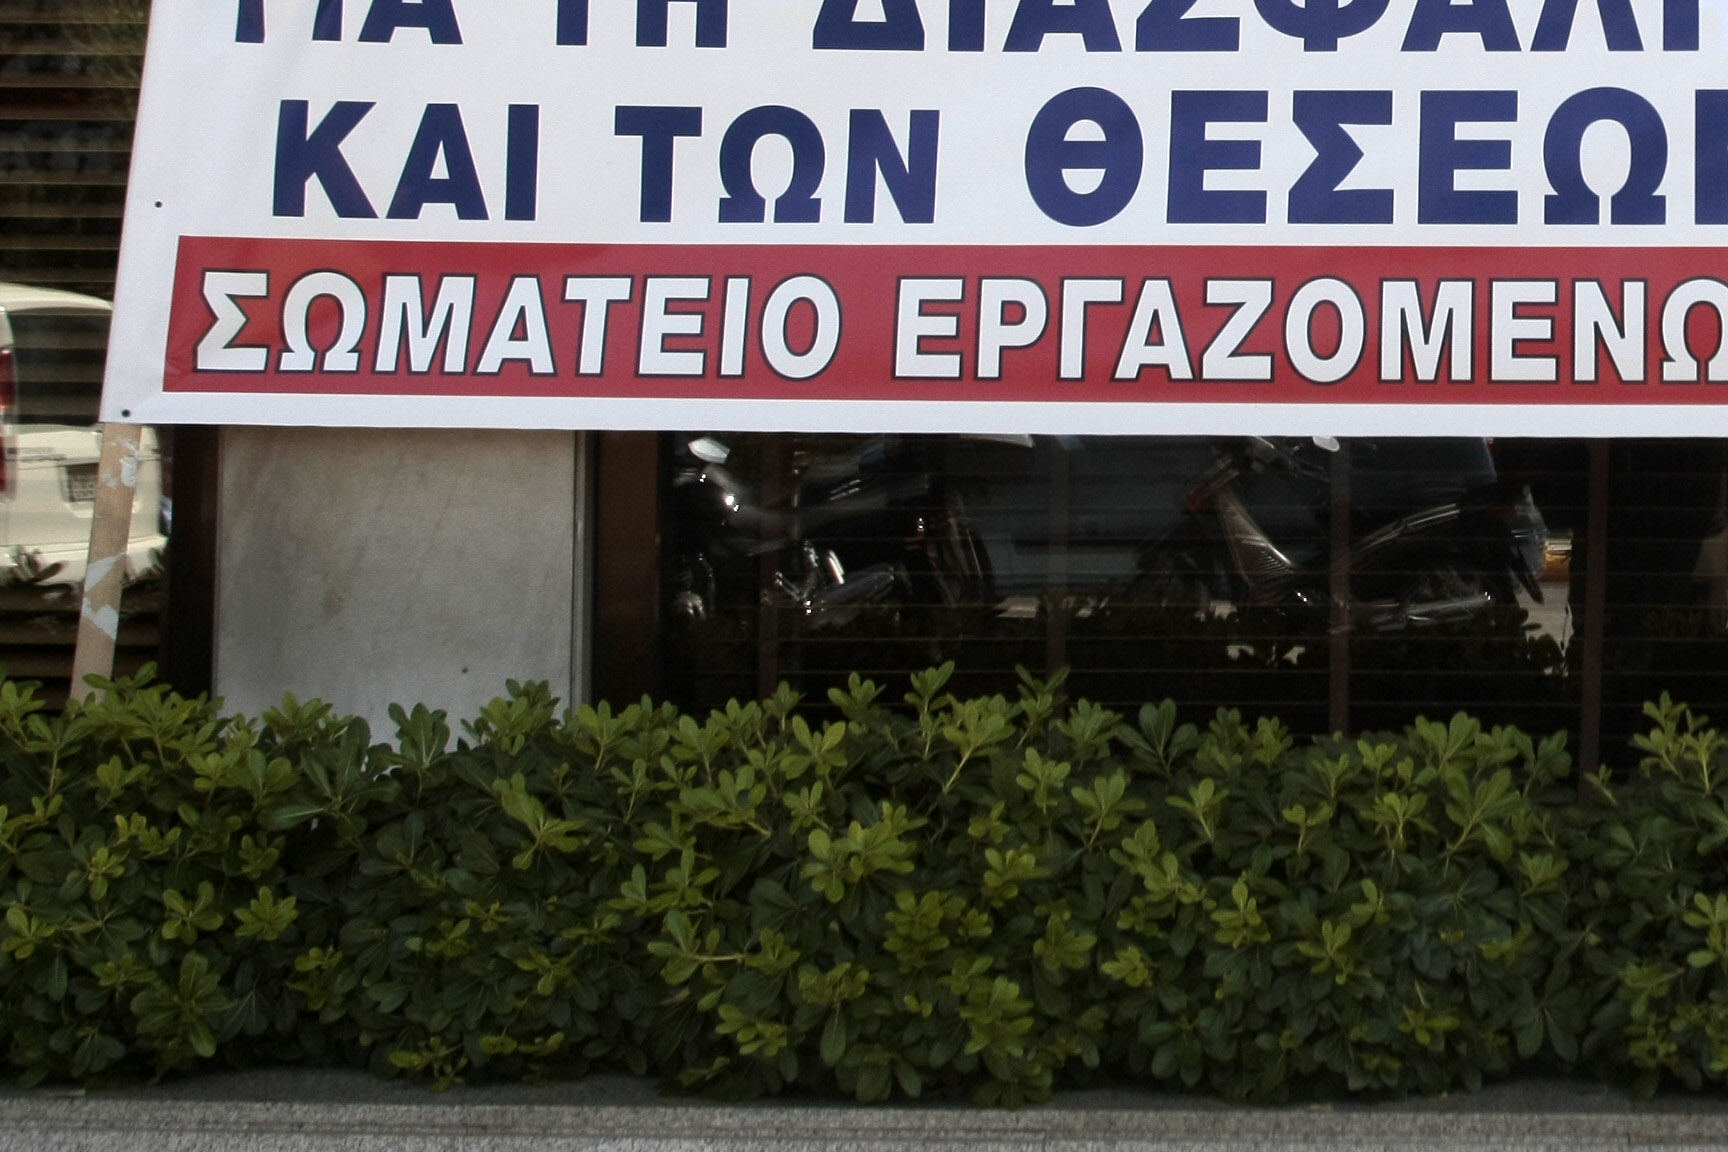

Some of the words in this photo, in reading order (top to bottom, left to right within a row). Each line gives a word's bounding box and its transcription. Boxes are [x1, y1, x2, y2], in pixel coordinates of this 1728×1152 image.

[273, 100, 538, 221] ΚΑΙ
[615, 105, 940, 224] ΤΩΝ
[196, 270, 840, 380] ΣΩΜΑΤΕΙΟ
